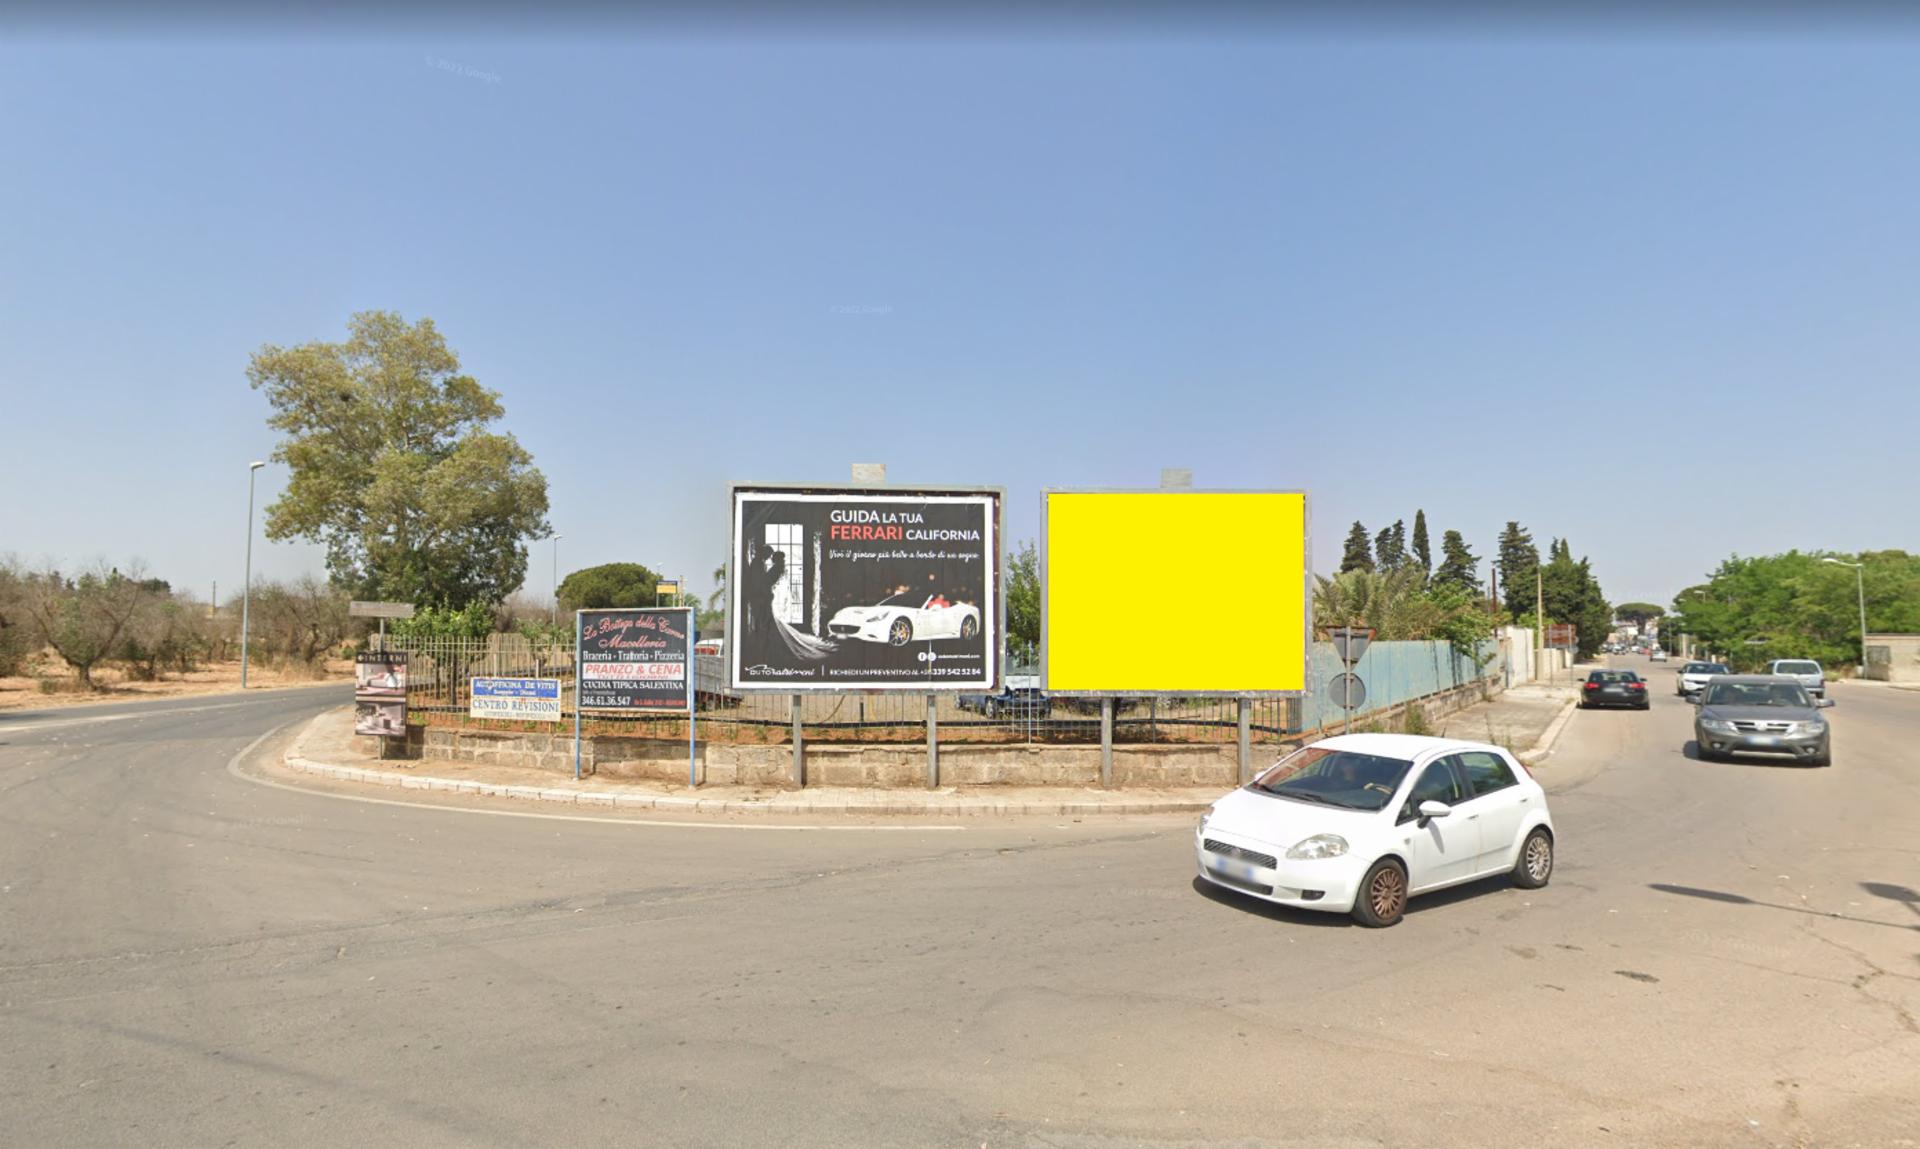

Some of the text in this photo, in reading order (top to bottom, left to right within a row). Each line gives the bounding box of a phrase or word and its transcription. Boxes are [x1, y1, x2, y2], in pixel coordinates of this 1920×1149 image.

[830, 510, 924, 523] GUIDA LA TUA
[831, 525, 980, 540] FERRARI CALIFORNIA
[583, 650, 612, 660] Braceria
[617, 650, 649, 660] Trattoria
[585, 664, 682, 675] PRANZO & CENA
[583, 680, 684, 690] CUCINA TIPICA SALENTINA
[473, 699, 559, 712] CENTRO REVISIONI
